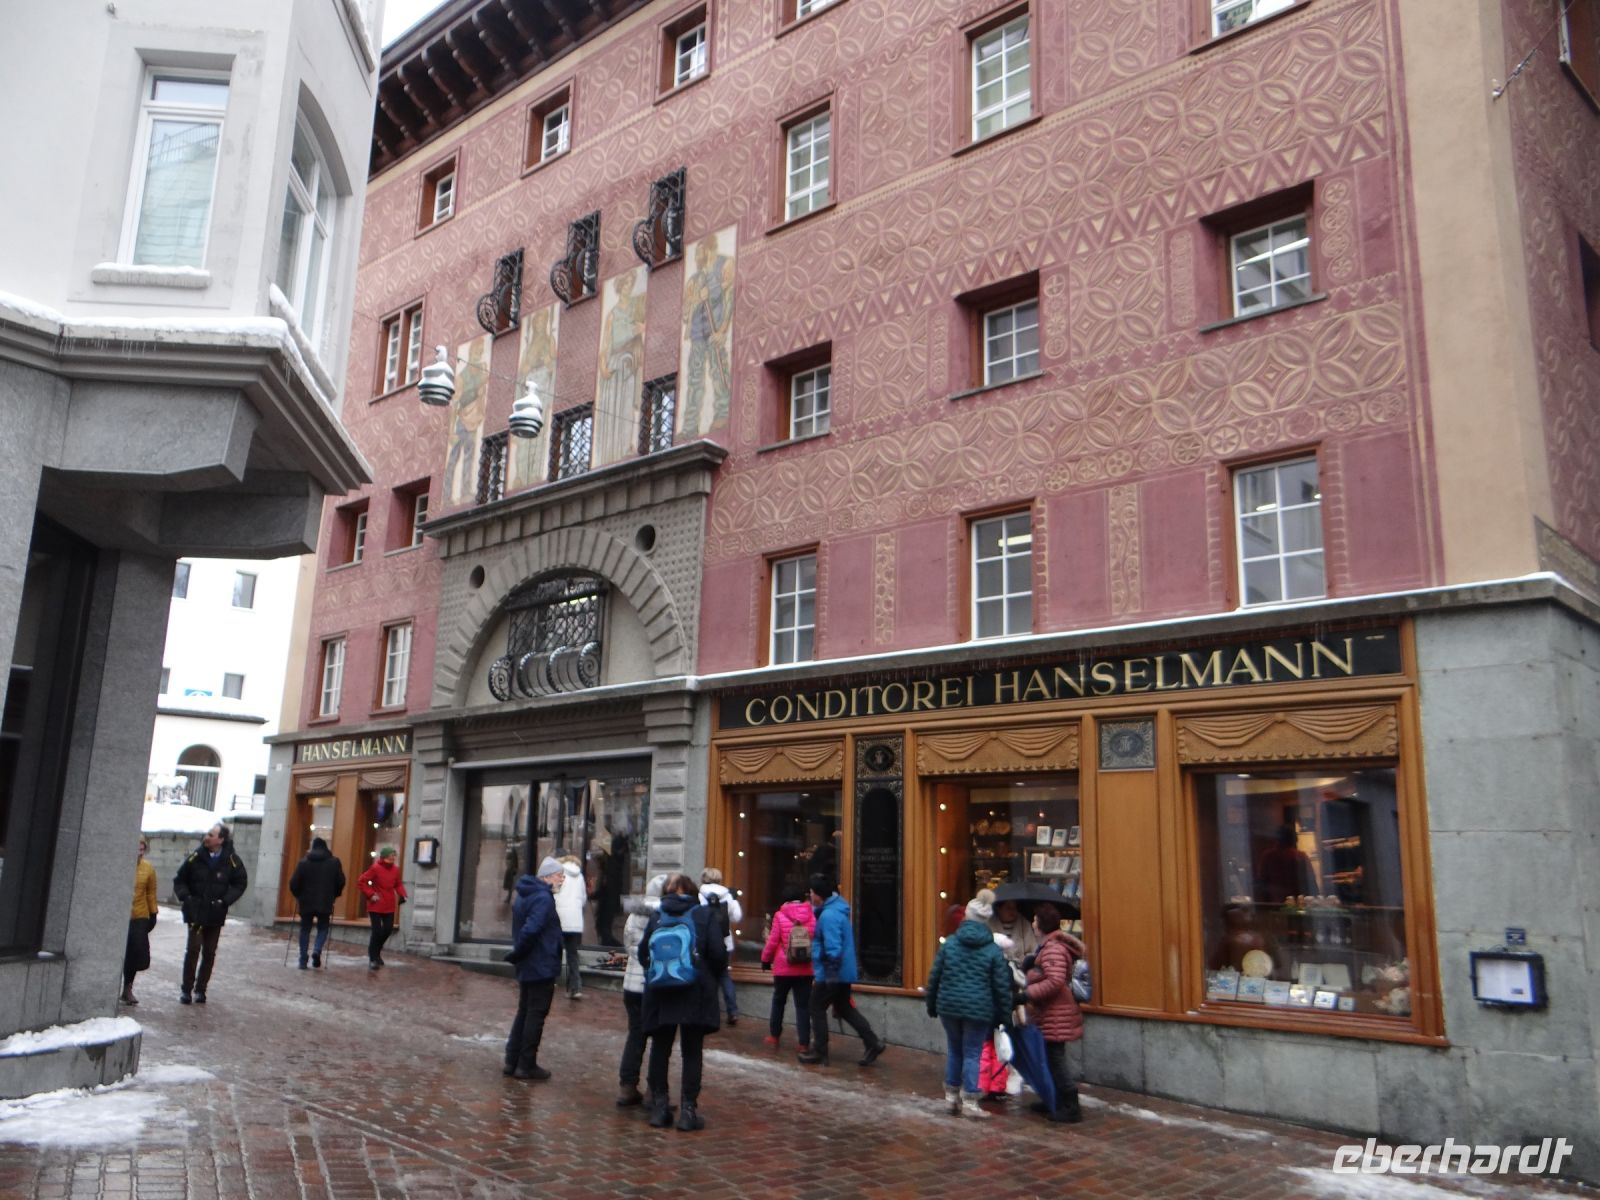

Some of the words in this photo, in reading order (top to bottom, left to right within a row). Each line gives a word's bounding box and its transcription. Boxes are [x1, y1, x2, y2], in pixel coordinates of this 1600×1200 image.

[745, 675, 974, 727] CONDITOREI
[995, 637, 1355, 705] HANSELMANN
[302, 733, 408, 763] HANSELMANN
